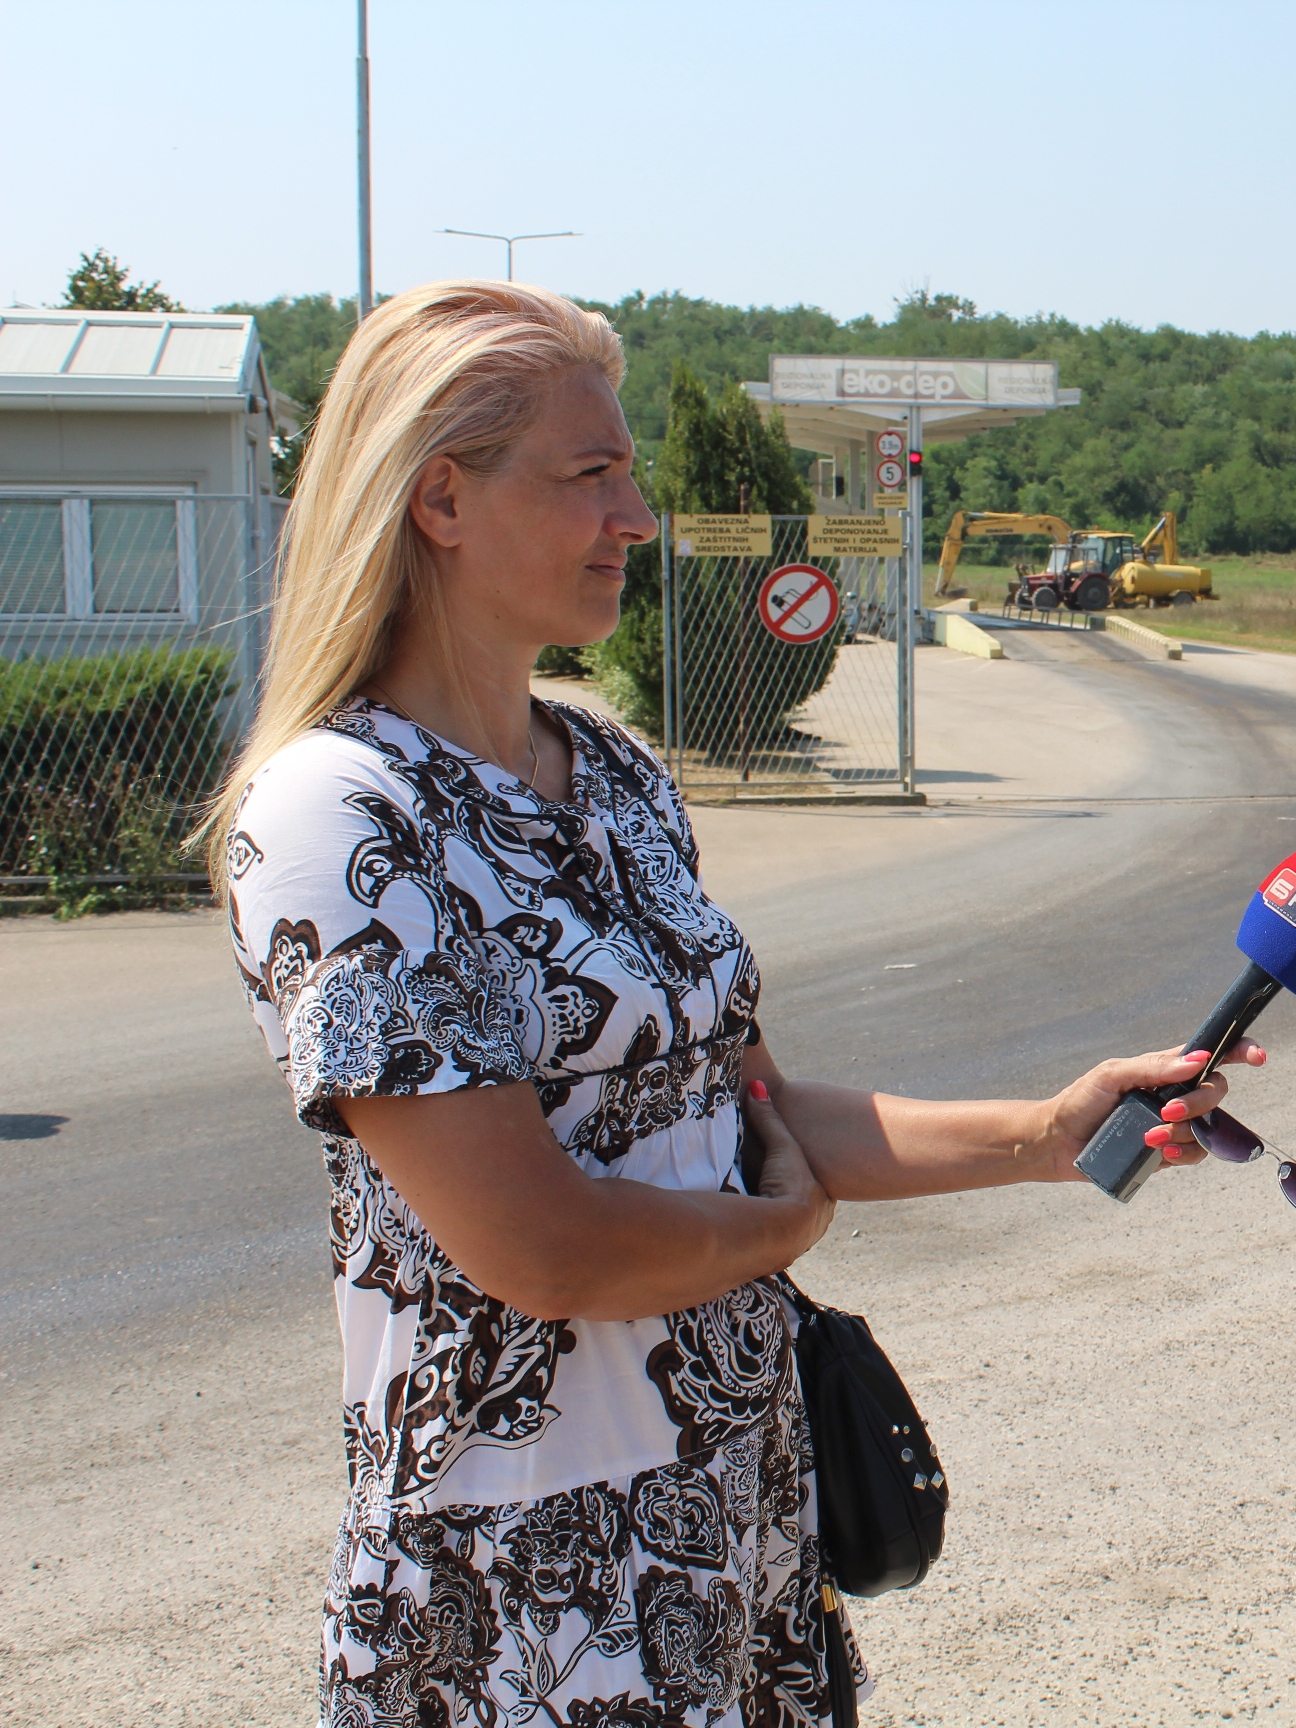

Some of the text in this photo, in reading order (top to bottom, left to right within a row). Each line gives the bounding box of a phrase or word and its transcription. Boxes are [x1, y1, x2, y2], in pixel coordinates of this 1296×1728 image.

[886, 466, 895, 481] 5
[697, 517, 750, 525] OBAVEZNA
[825, 518, 886, 526] ZABRANJENO
[735, 525, 767, 534] LIČNIH
[698, 535, 749, 543] ZAŠTITNIH
[812, 535, 849, 544] ŠTETNIH
[1095, 1109, 1130, 1153] SENNHEISER
